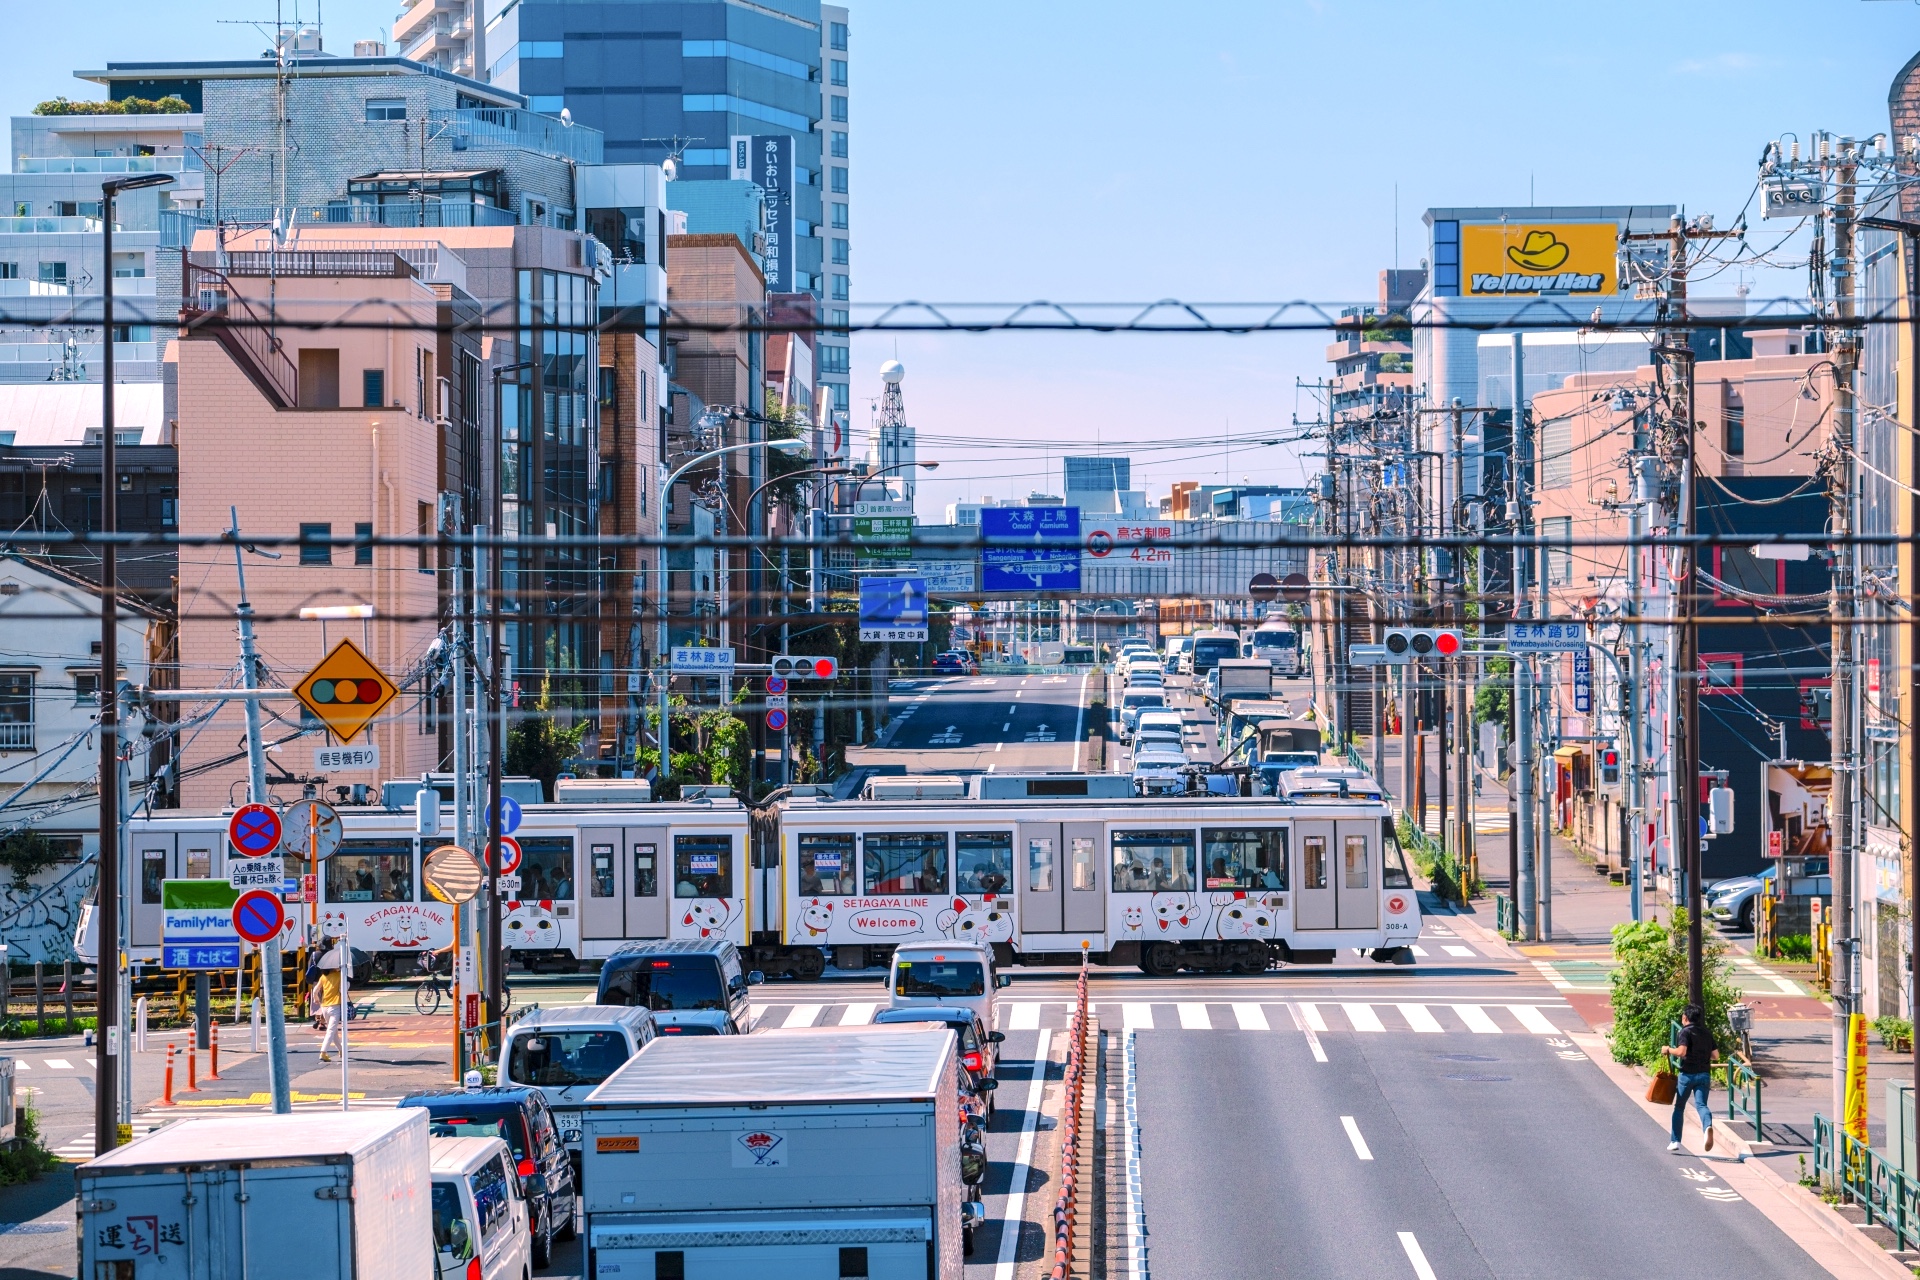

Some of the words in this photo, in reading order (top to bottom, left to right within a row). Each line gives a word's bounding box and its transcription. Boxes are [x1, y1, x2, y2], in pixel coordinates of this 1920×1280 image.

[766, 140, 779, 285] あいおいニッセイ同和損保
[1009, 511, 1034, 522] 大森
[1041, 510, 1067, 521] 上馬
[883, 519, 908, 527] 三軒茶屋
[1117, 527, 1171, 540] 高さ制限
[988, 554, 1024, 562] Sangenjaya
[1130, 547, 1171, 562] 4.2m
[1024, 564, 1060, 573] 世田谷通り
[1514, 623, 1580, 639] 若林踏切
[1510, 640, 1554, 649] Wakabayashi
[1554, 640, 1584, 649] Crossing
[676, 651, 730, 663] 若林踏切
[319, 751, 374, 767] 信号機有り
[246, 805, 265, 813] 7-9
[233, 862, 281, 874] 人の乗降を除く
[233, 873, 282, 886] 日曜・休日を除く
[843, 898, 901, 908] SETAGAYA
[904, 898, 929, 908] LINE
[364, 905, 420, 927] SETAGAYA
[422, 908, 446, 926] LINE
[857, 917, 917, 928] Welcome
[172, 948, 190, 967] 酒
[196, 950, 233, 964] たばこ
[1855, 1018, 1868, 1057] 自転車
[598, 1140, 638, 1148] トランテックス
[99, 1224, 125, 1250] 運
[160, 1222, 185, 1246] 送
